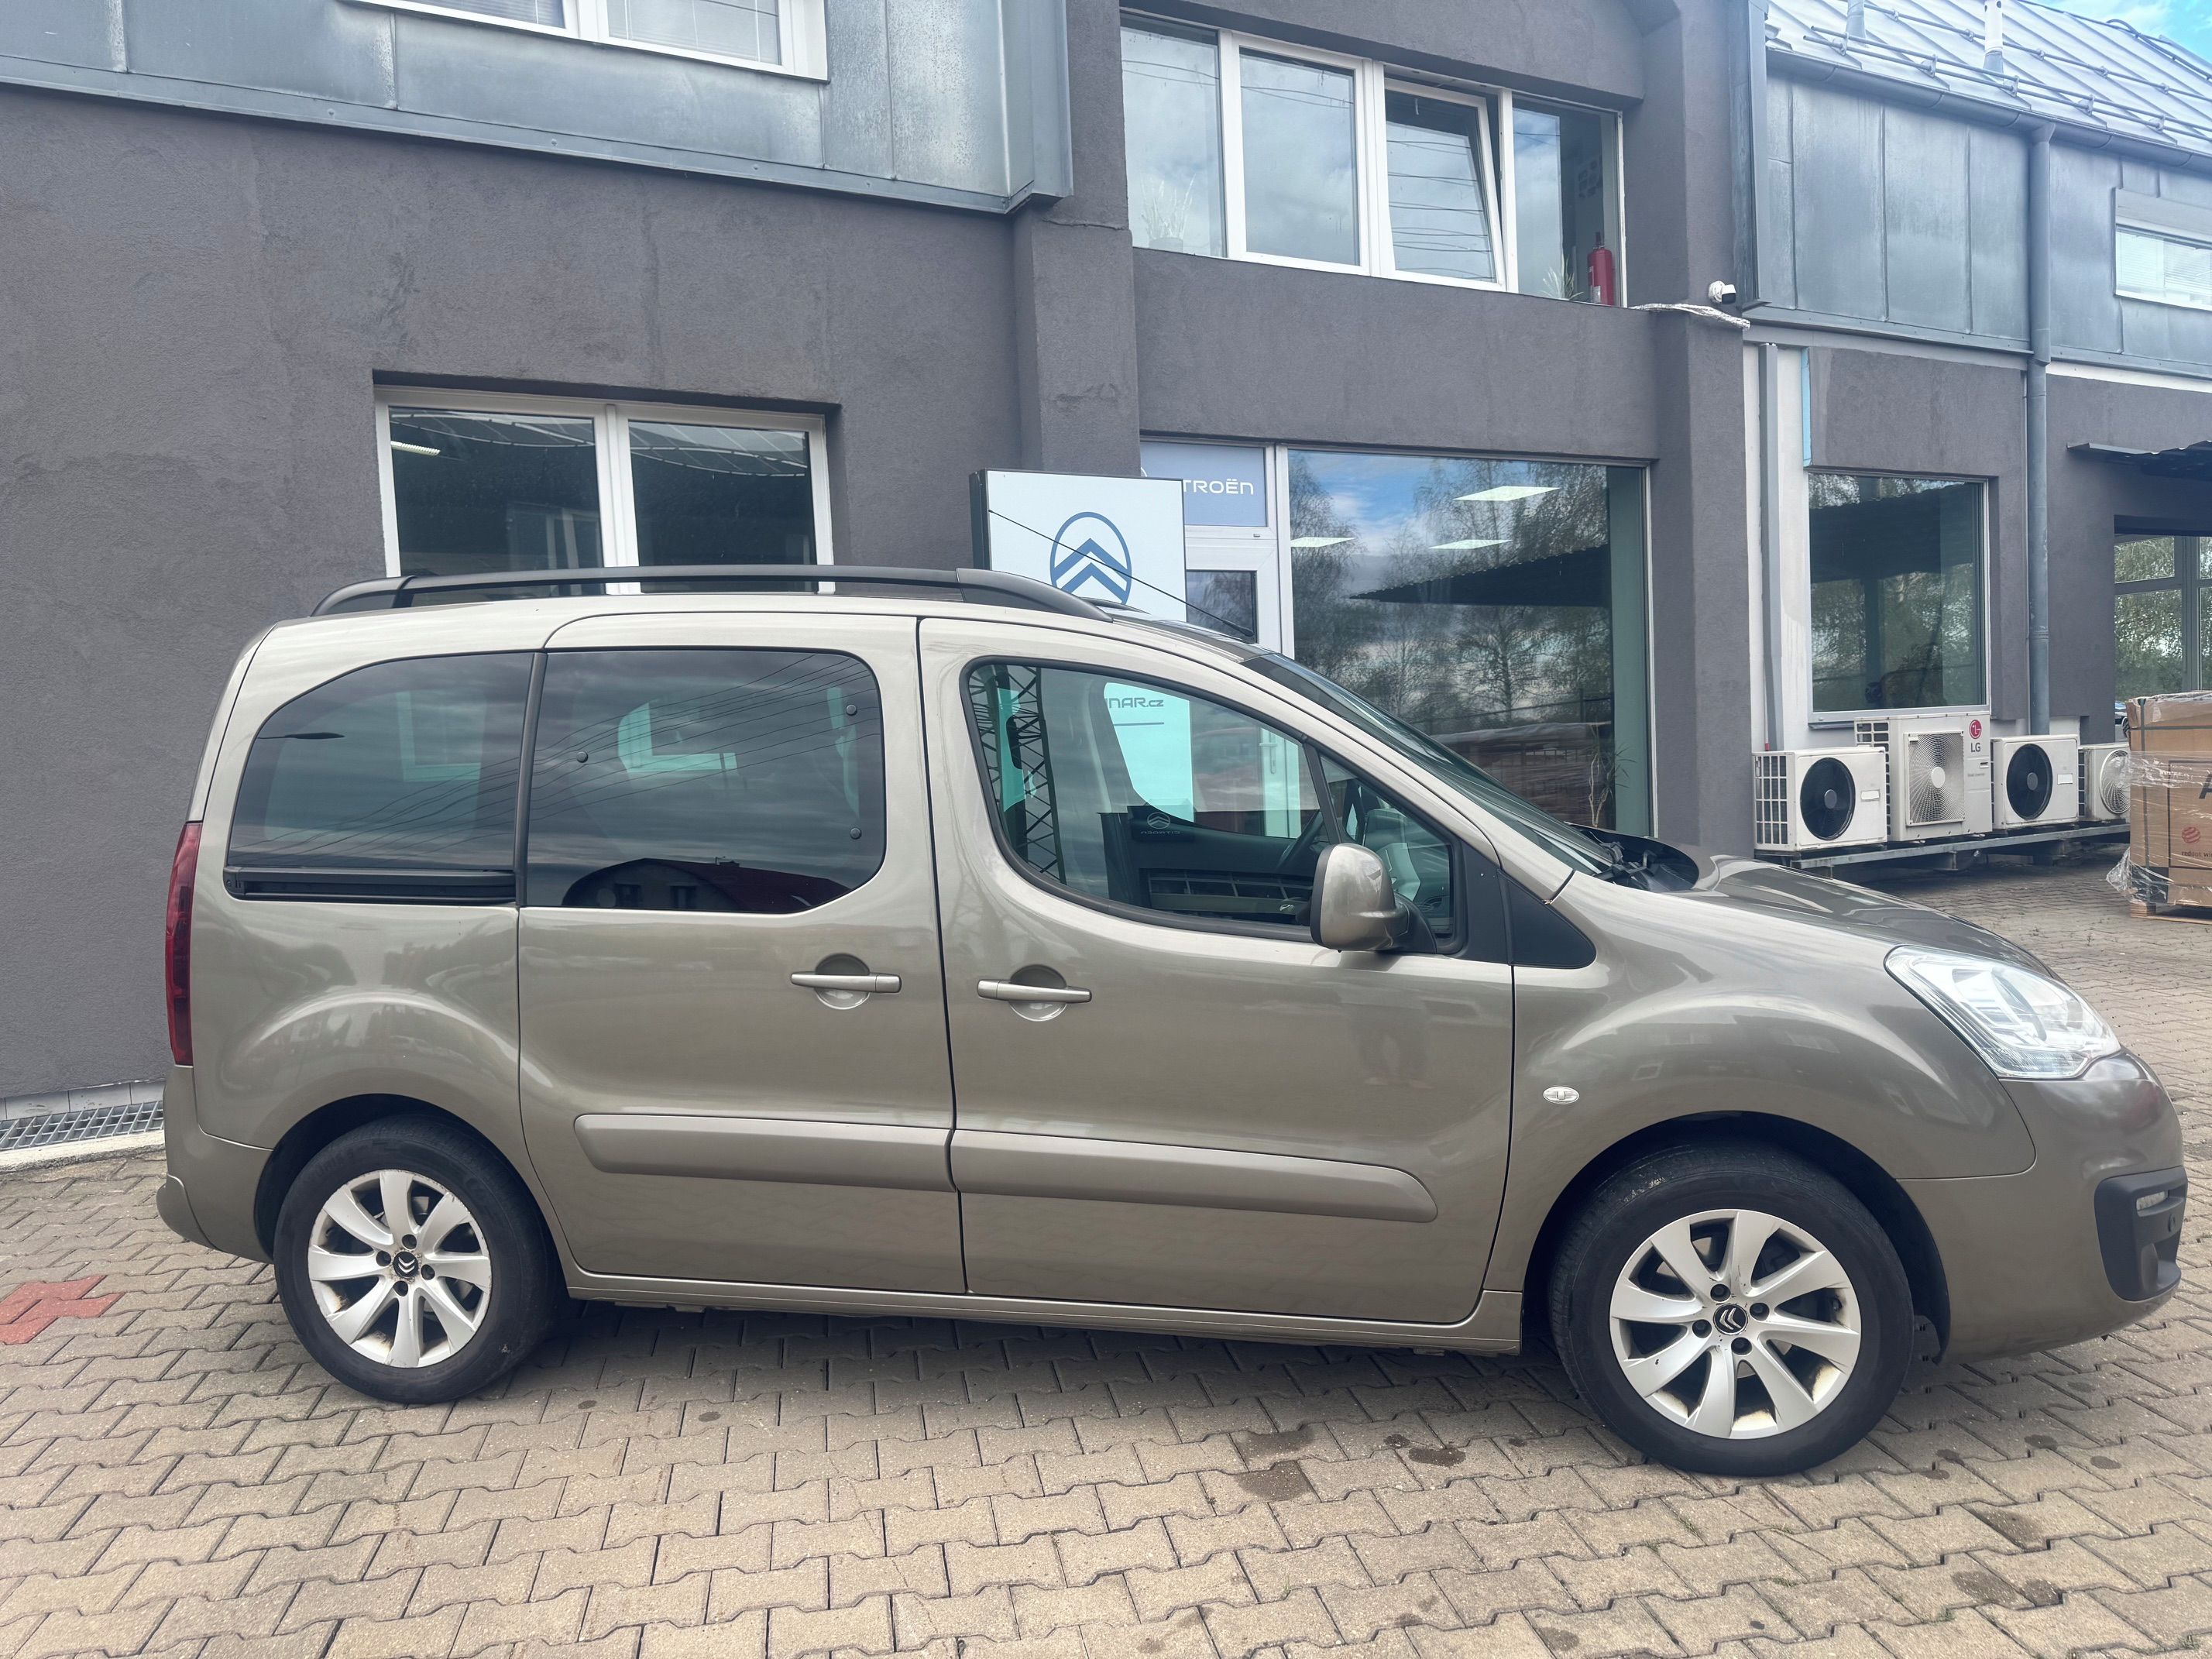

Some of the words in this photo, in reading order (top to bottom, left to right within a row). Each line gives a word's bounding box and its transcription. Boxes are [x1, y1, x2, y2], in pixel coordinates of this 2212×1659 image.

[1183, 478, 1254, 495] TROËN
[1105, 697, 1164, 709] NAR.cz
[1970, 742, 1981, 753] LG
